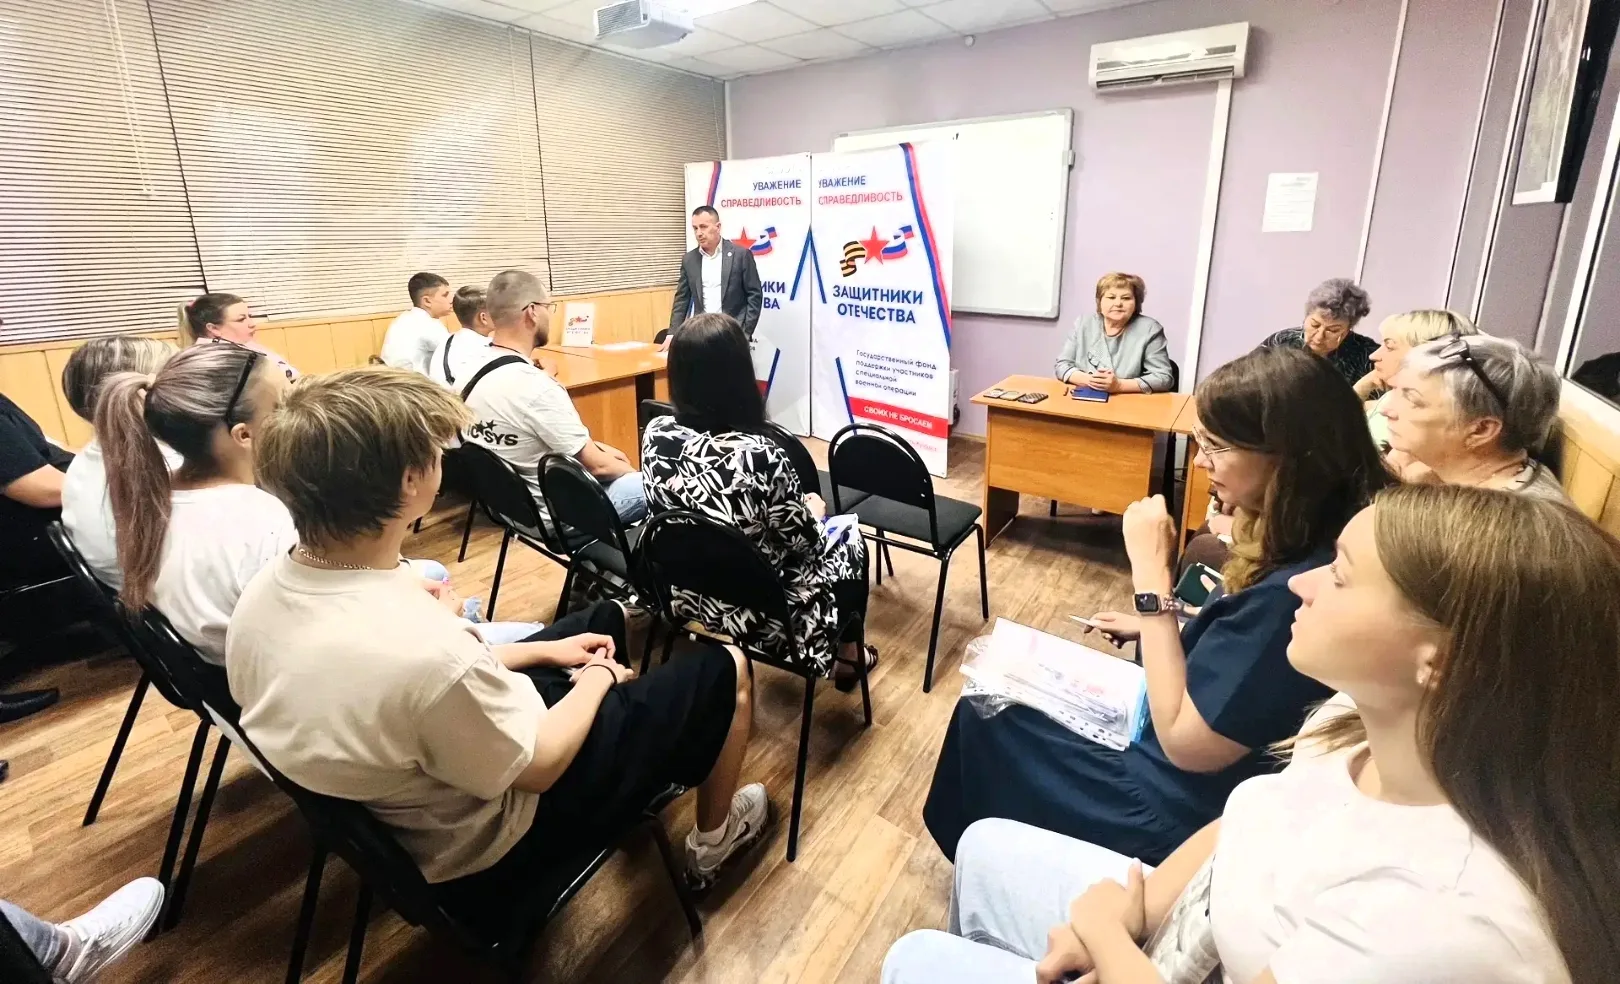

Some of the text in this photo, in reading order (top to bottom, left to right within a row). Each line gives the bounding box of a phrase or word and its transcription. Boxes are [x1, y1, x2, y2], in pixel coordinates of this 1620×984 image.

[753, 180, 802, 191] УВАЖЕНИЕ
[818, 175, 867, 189] УВАЖЕНИЕ
[721, 196, 802, 208] СПРАВЕДЛИВОСТЬ
[818, 191, 903, 205] СПРАВЕДЛИВОСТЬ
[833, 284, 923, 305] ЗАЩИТНИКИ
[837, 303, 916, 324] ОТЕЧЕСТВА
[856, 349, 937, 371] Государственный фонд
[855, 360, 934, 380] поддержки участников
[855, 369, 898, 382] специальной
[883, 385, 917, 397] операции
[863, 405, 933, 430] СВОИХ НЕ БРОСАЕМ
